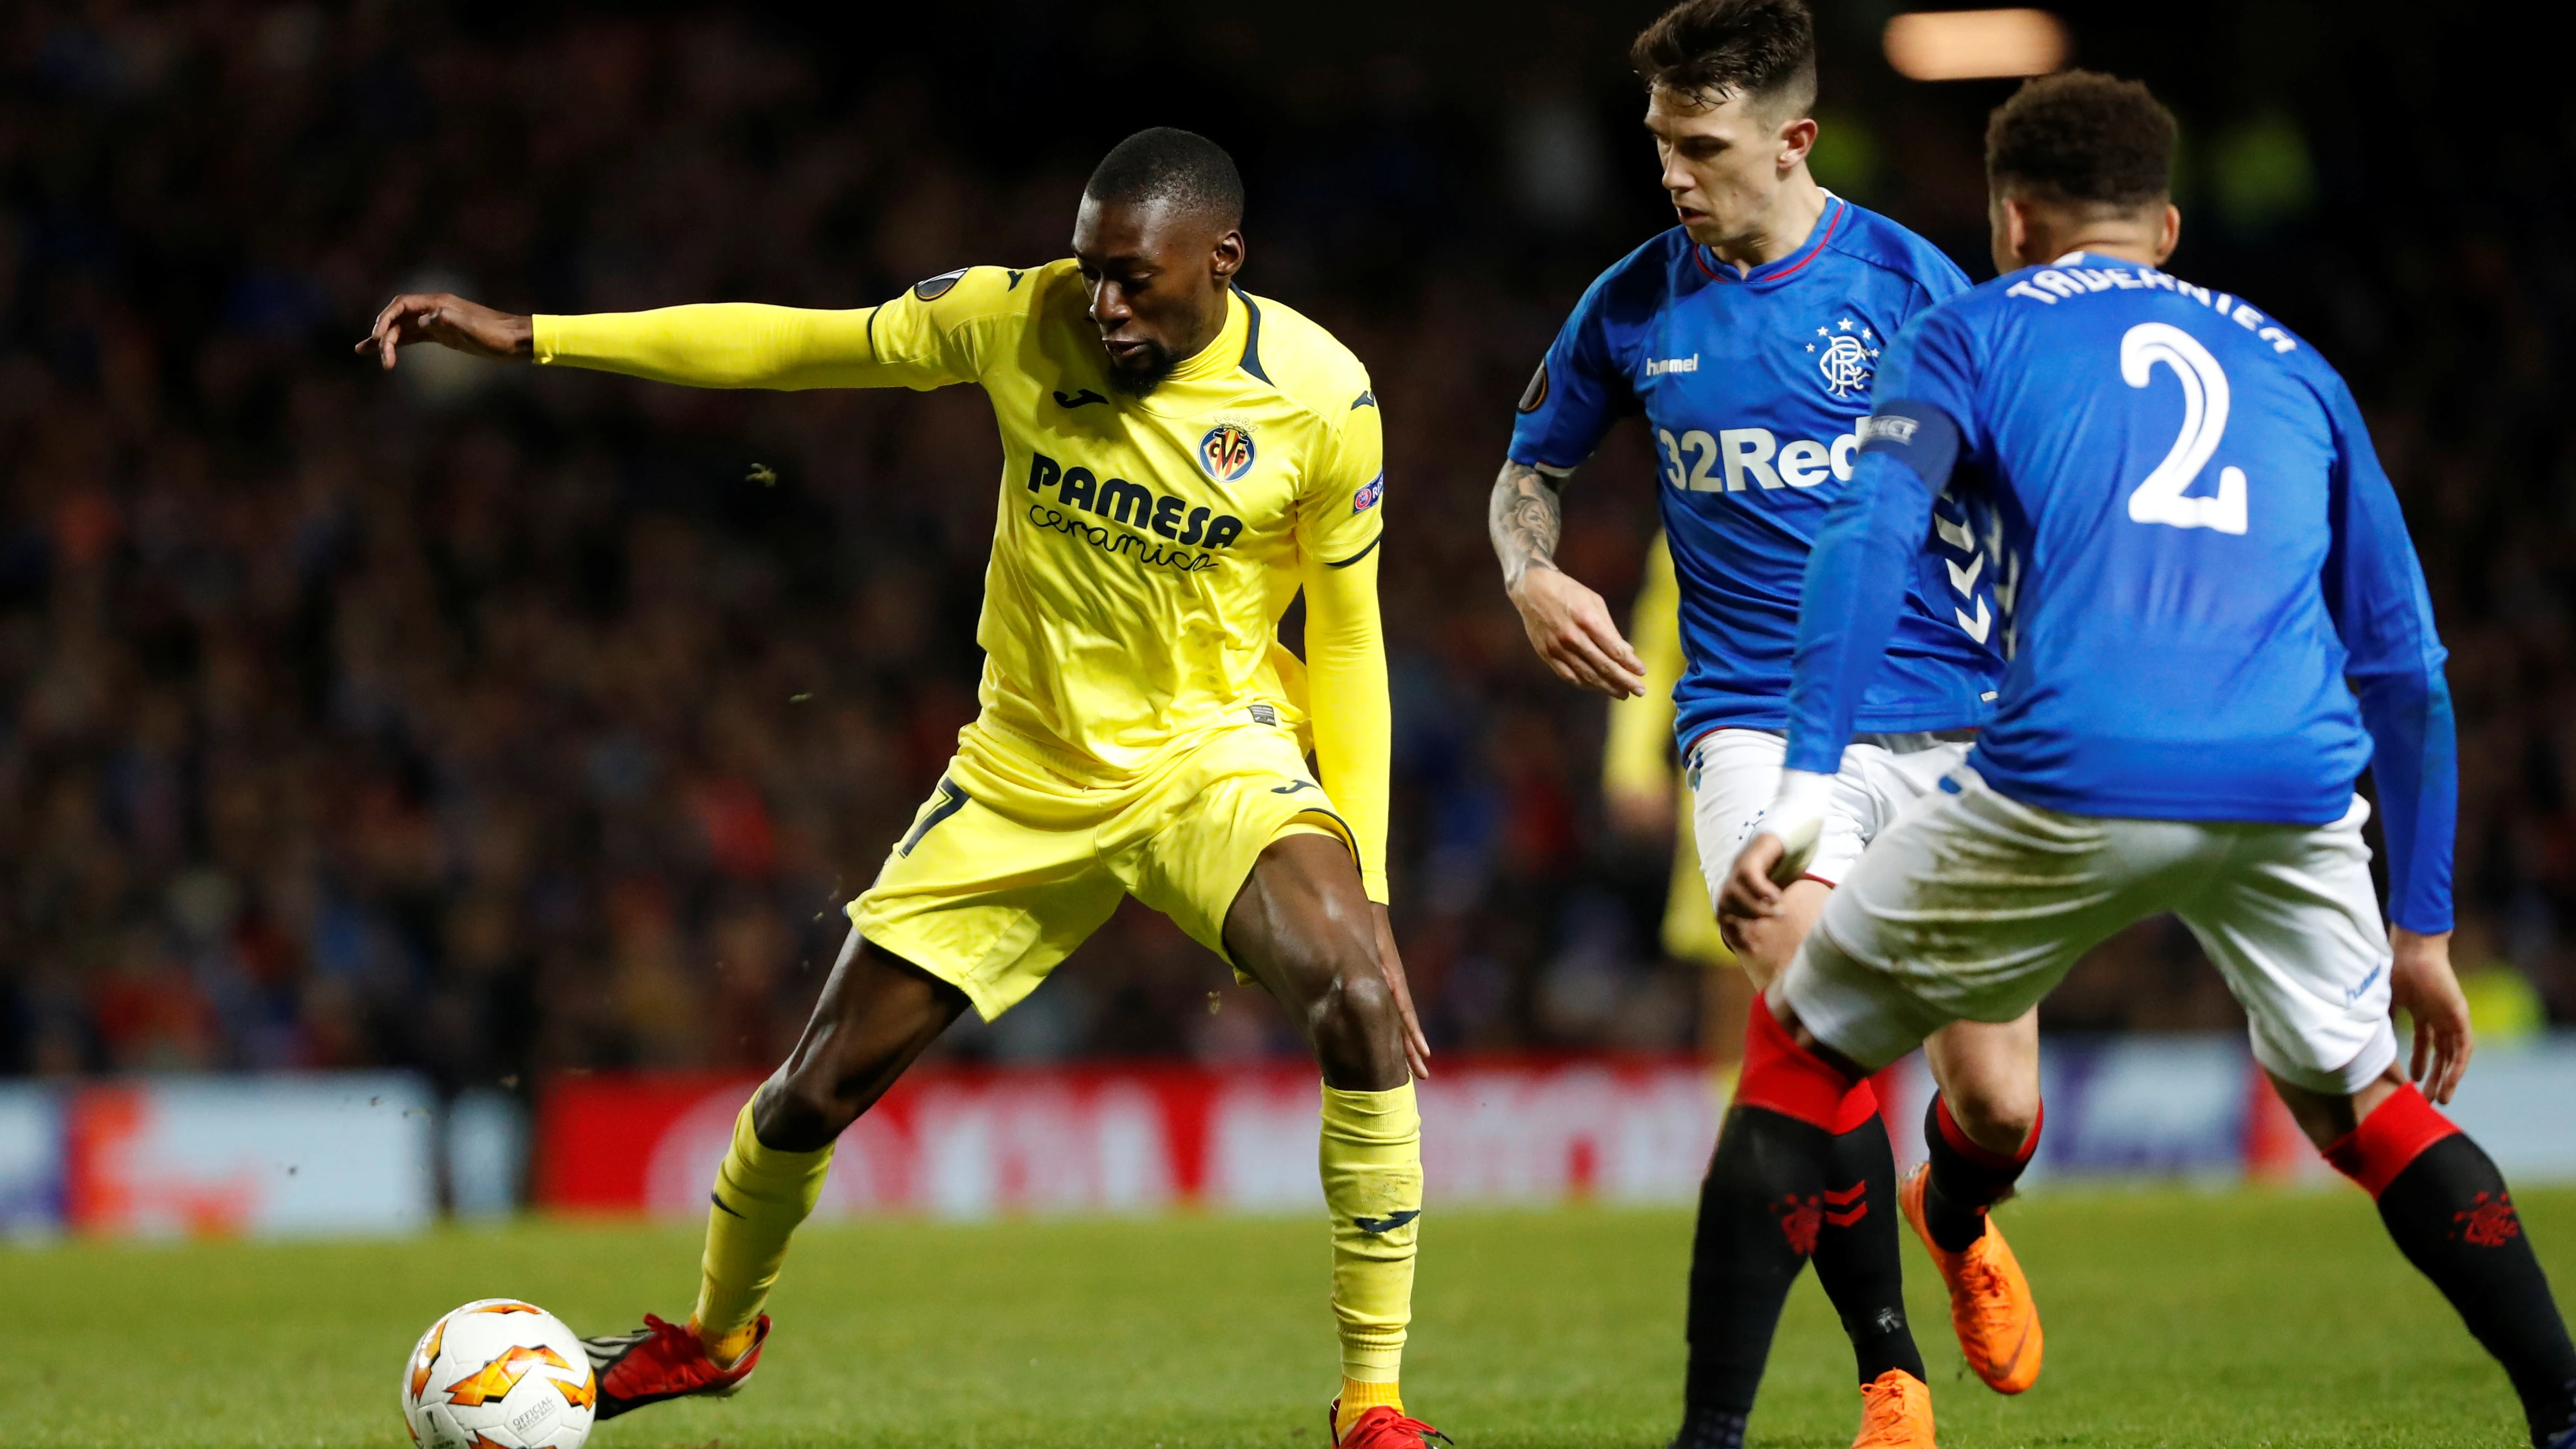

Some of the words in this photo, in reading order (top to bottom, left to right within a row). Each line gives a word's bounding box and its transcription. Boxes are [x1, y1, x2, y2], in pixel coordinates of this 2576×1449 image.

[1646, 353, 1698, 376] hummel
[1659, 416, 1872, 492] 32Red
[2120, 322, 2248, 535] 2
[1028, 452, 1243, 550] PAMESA
[1030, 505, 1219, 572] ceramica
[898, 776, 971, 859] 7
[513, 1397, 552, 1426] OFFICIAL
